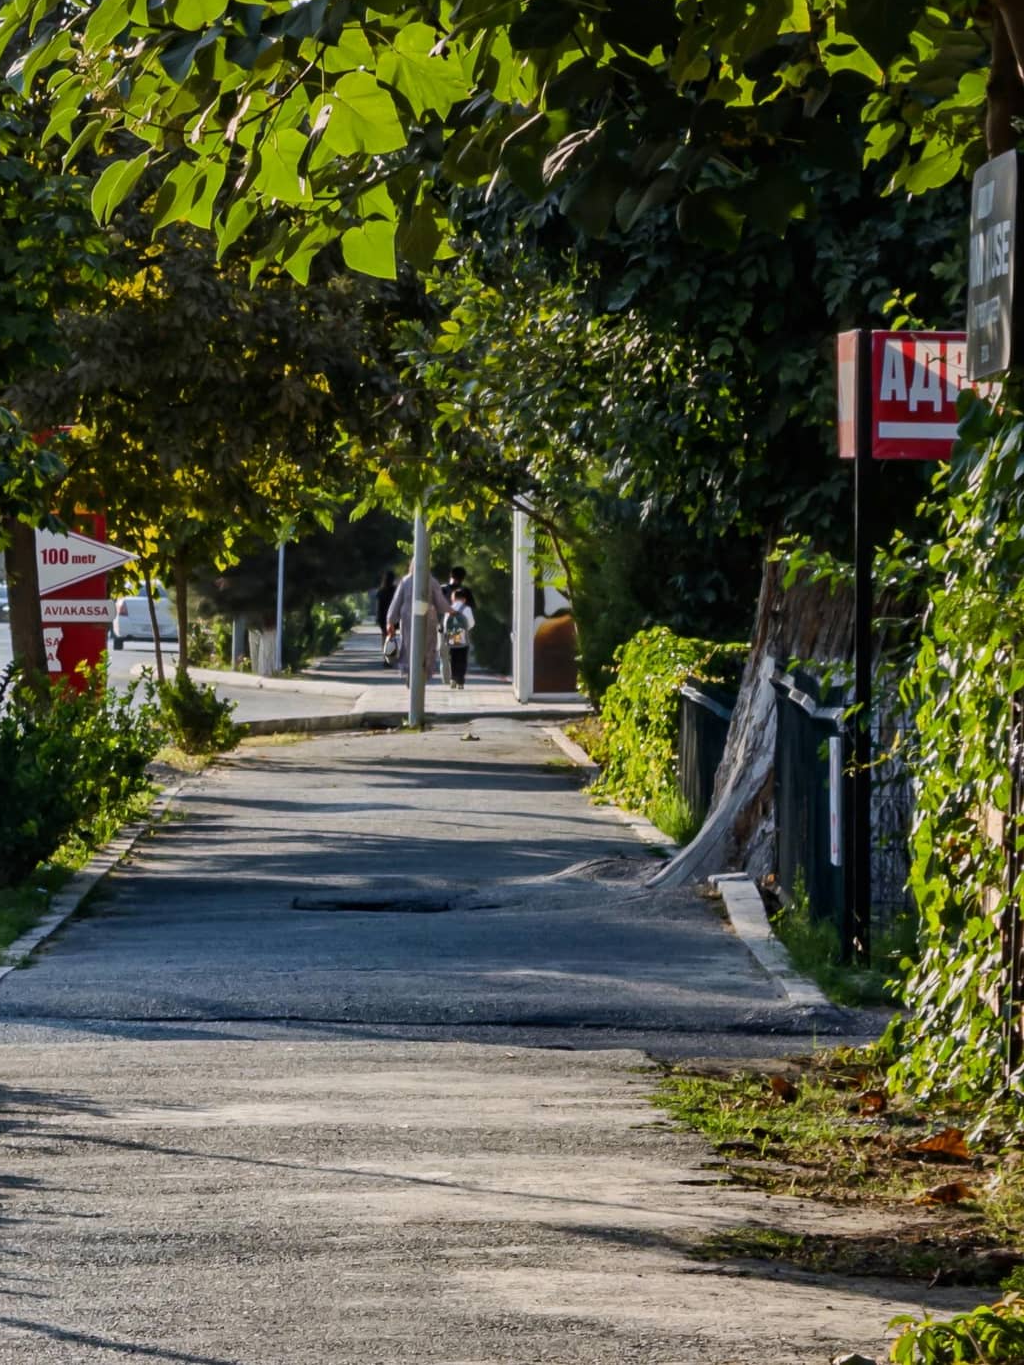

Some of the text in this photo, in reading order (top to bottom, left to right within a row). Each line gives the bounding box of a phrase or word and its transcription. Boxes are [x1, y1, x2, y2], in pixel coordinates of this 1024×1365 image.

[41, 548, 97, 565] 100 metr
[44, 606, 109, 616] AVIAKASSA
